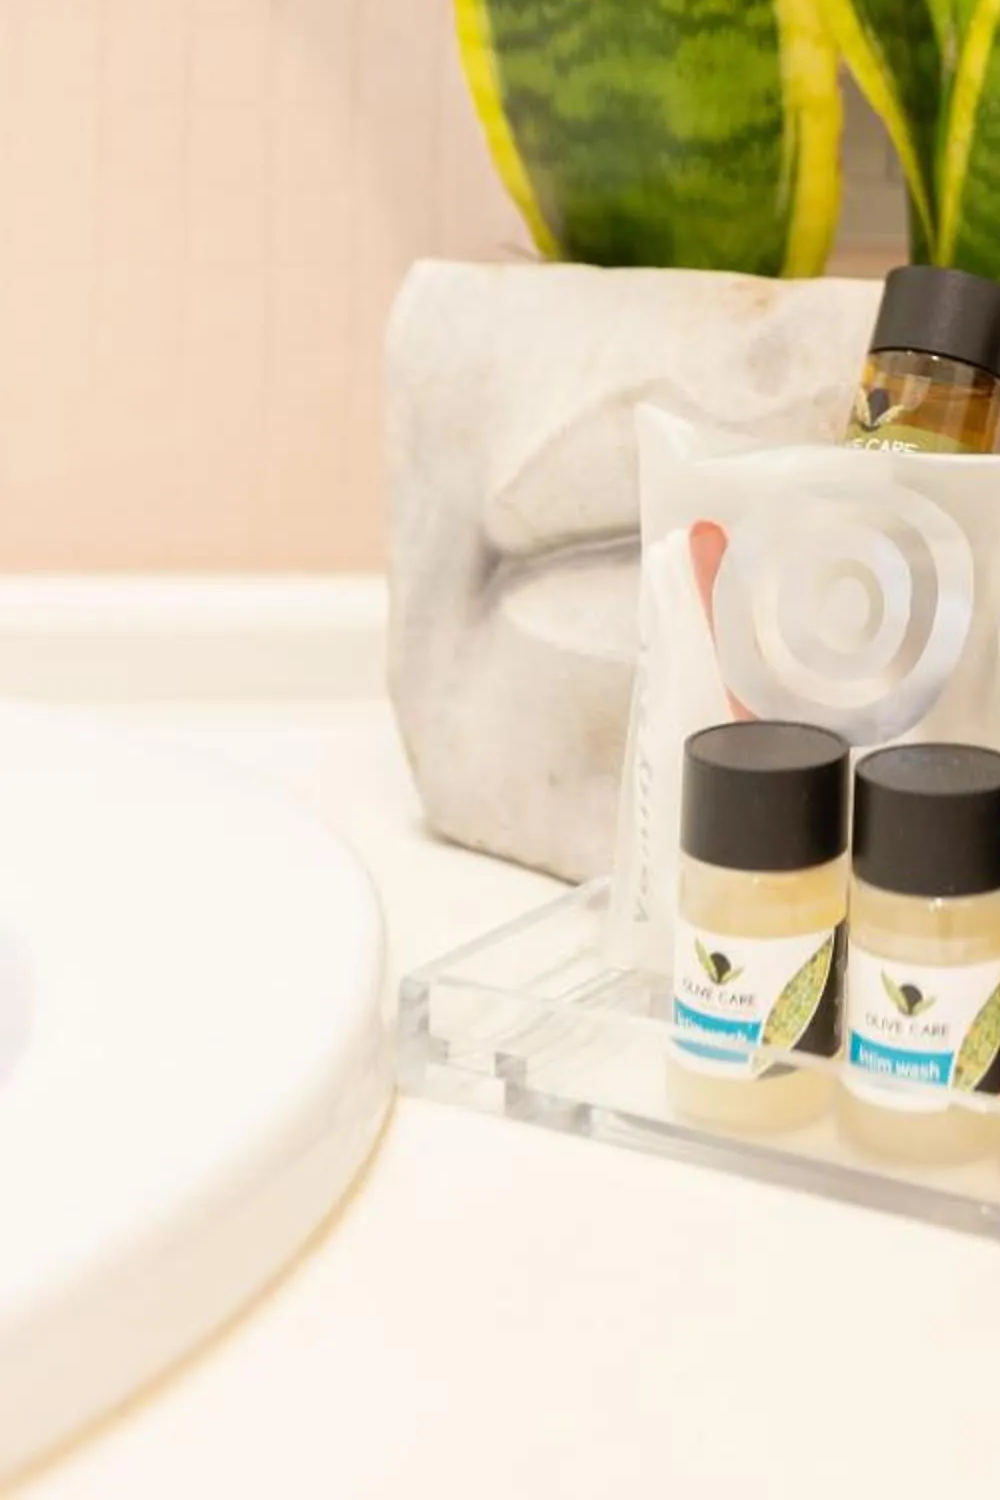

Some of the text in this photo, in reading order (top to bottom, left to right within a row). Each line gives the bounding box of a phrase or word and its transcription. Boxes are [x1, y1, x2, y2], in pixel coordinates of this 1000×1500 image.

[718, 991, 755, 1006] CARE
[865, 1011, 948, 1037] OLIVE CARE
[895, 1058, 941, 1081] wash
